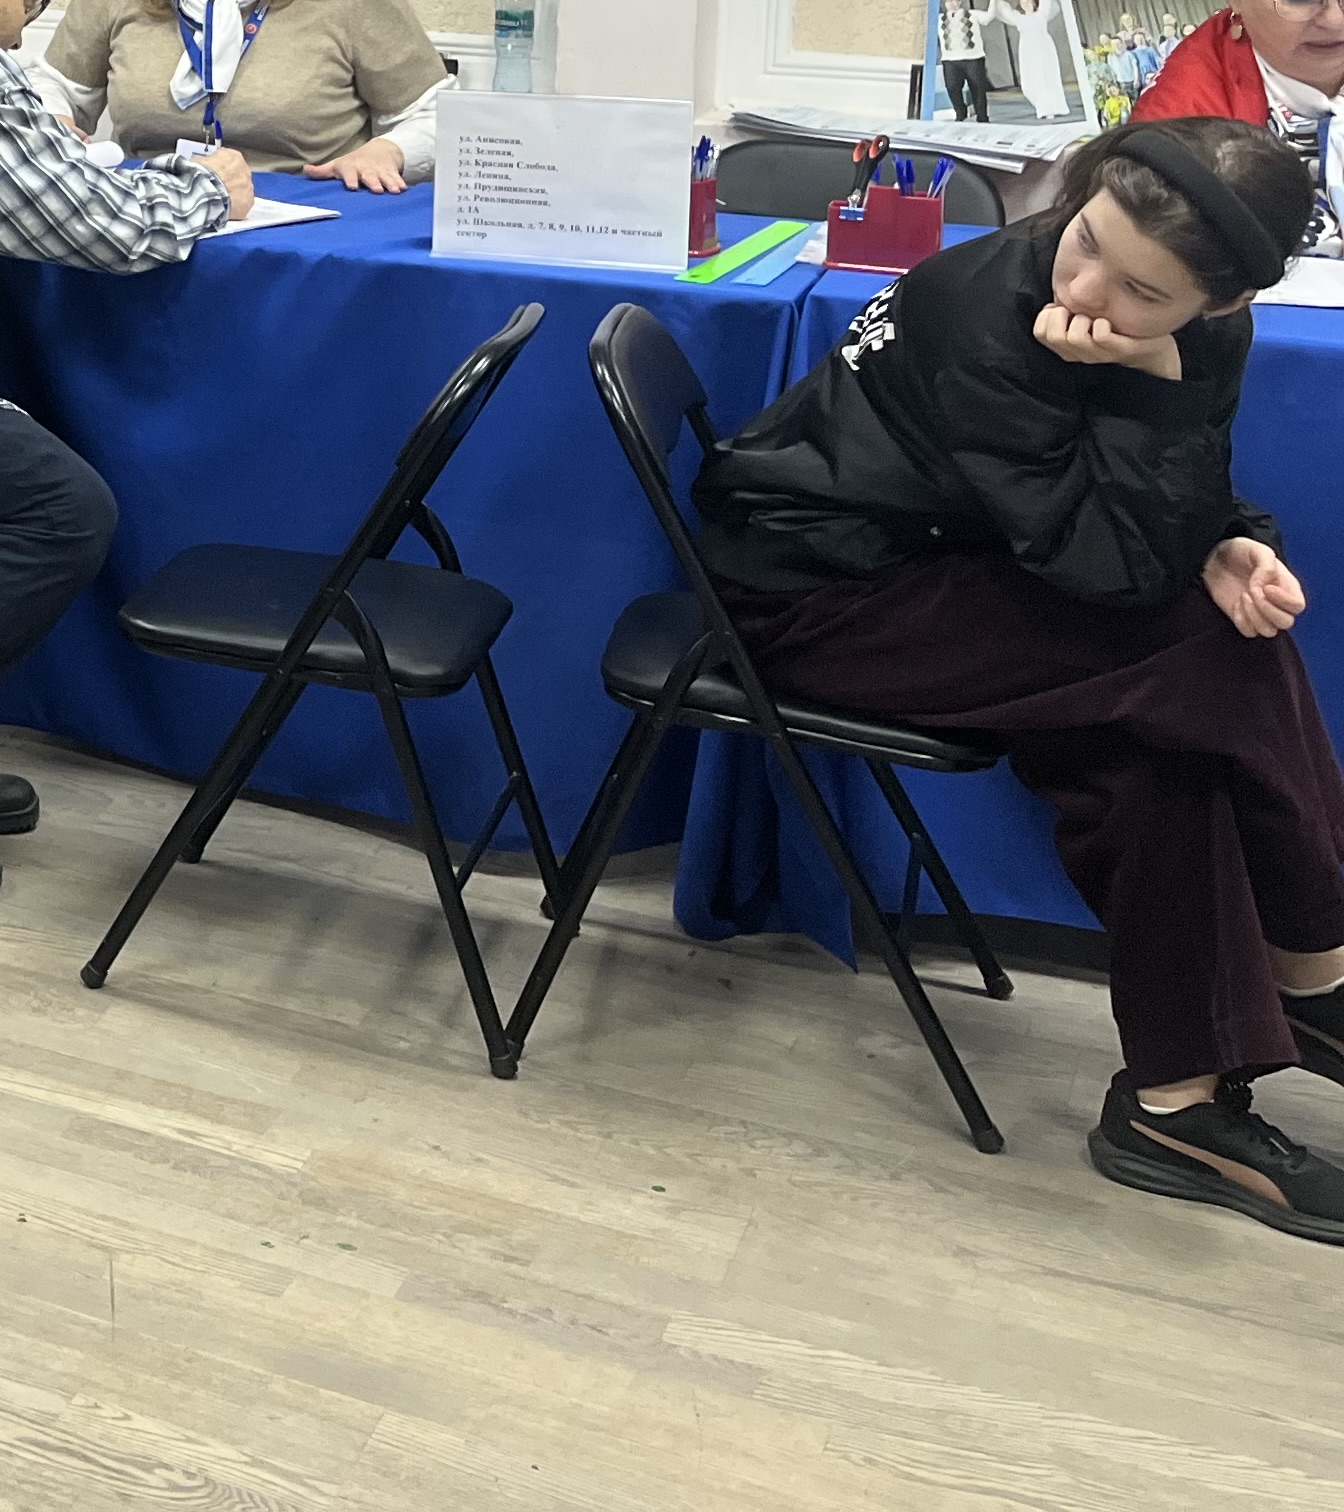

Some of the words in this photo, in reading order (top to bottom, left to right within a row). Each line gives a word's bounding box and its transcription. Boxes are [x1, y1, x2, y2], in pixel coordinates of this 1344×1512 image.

[459, 135, 472, 144] ул.
[458, 147, 472, 155] ул.
[458, 159, 471, 167] ул.
[474, 158, 514, 168] Красная
[516, 160, 559, 172] Слобода,
[458, 171, 471, 179] ул.
[474, 170, 512, 180] Ленина,
[473, 194, 552, 207] Революционная,
[468, 205, 480, 214] 1А
[456, 218, 470, 226] ул.
[473, 217, 525, 229] Школьная,
[456, 230, 488, 240] сектор
